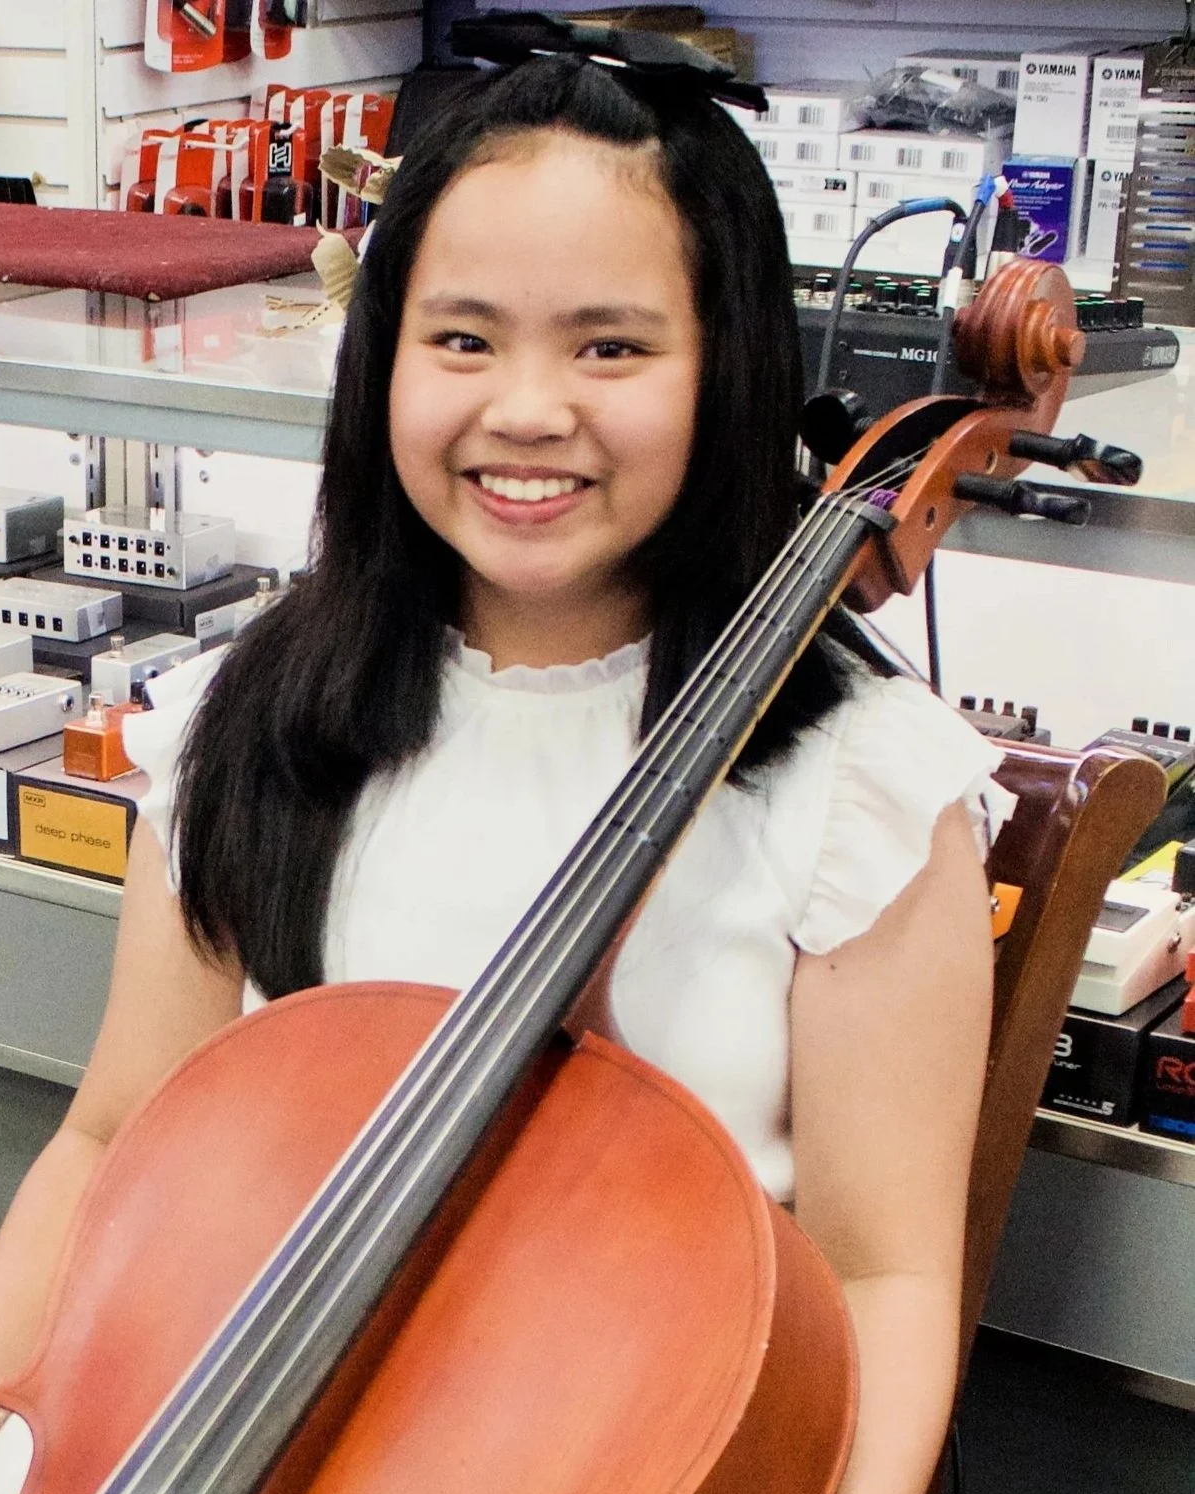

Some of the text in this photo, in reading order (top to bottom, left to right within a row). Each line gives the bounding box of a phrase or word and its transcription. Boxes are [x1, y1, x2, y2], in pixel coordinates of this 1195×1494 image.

[1038, 64, 1077, 76] YAMAHA
[1114, 69, 1141, 80] YAMA
[24, 794, 45, 806] MXR
[35, 823, 111, 849] deep phase
[1053, 1060, 1082, 1070] uner
